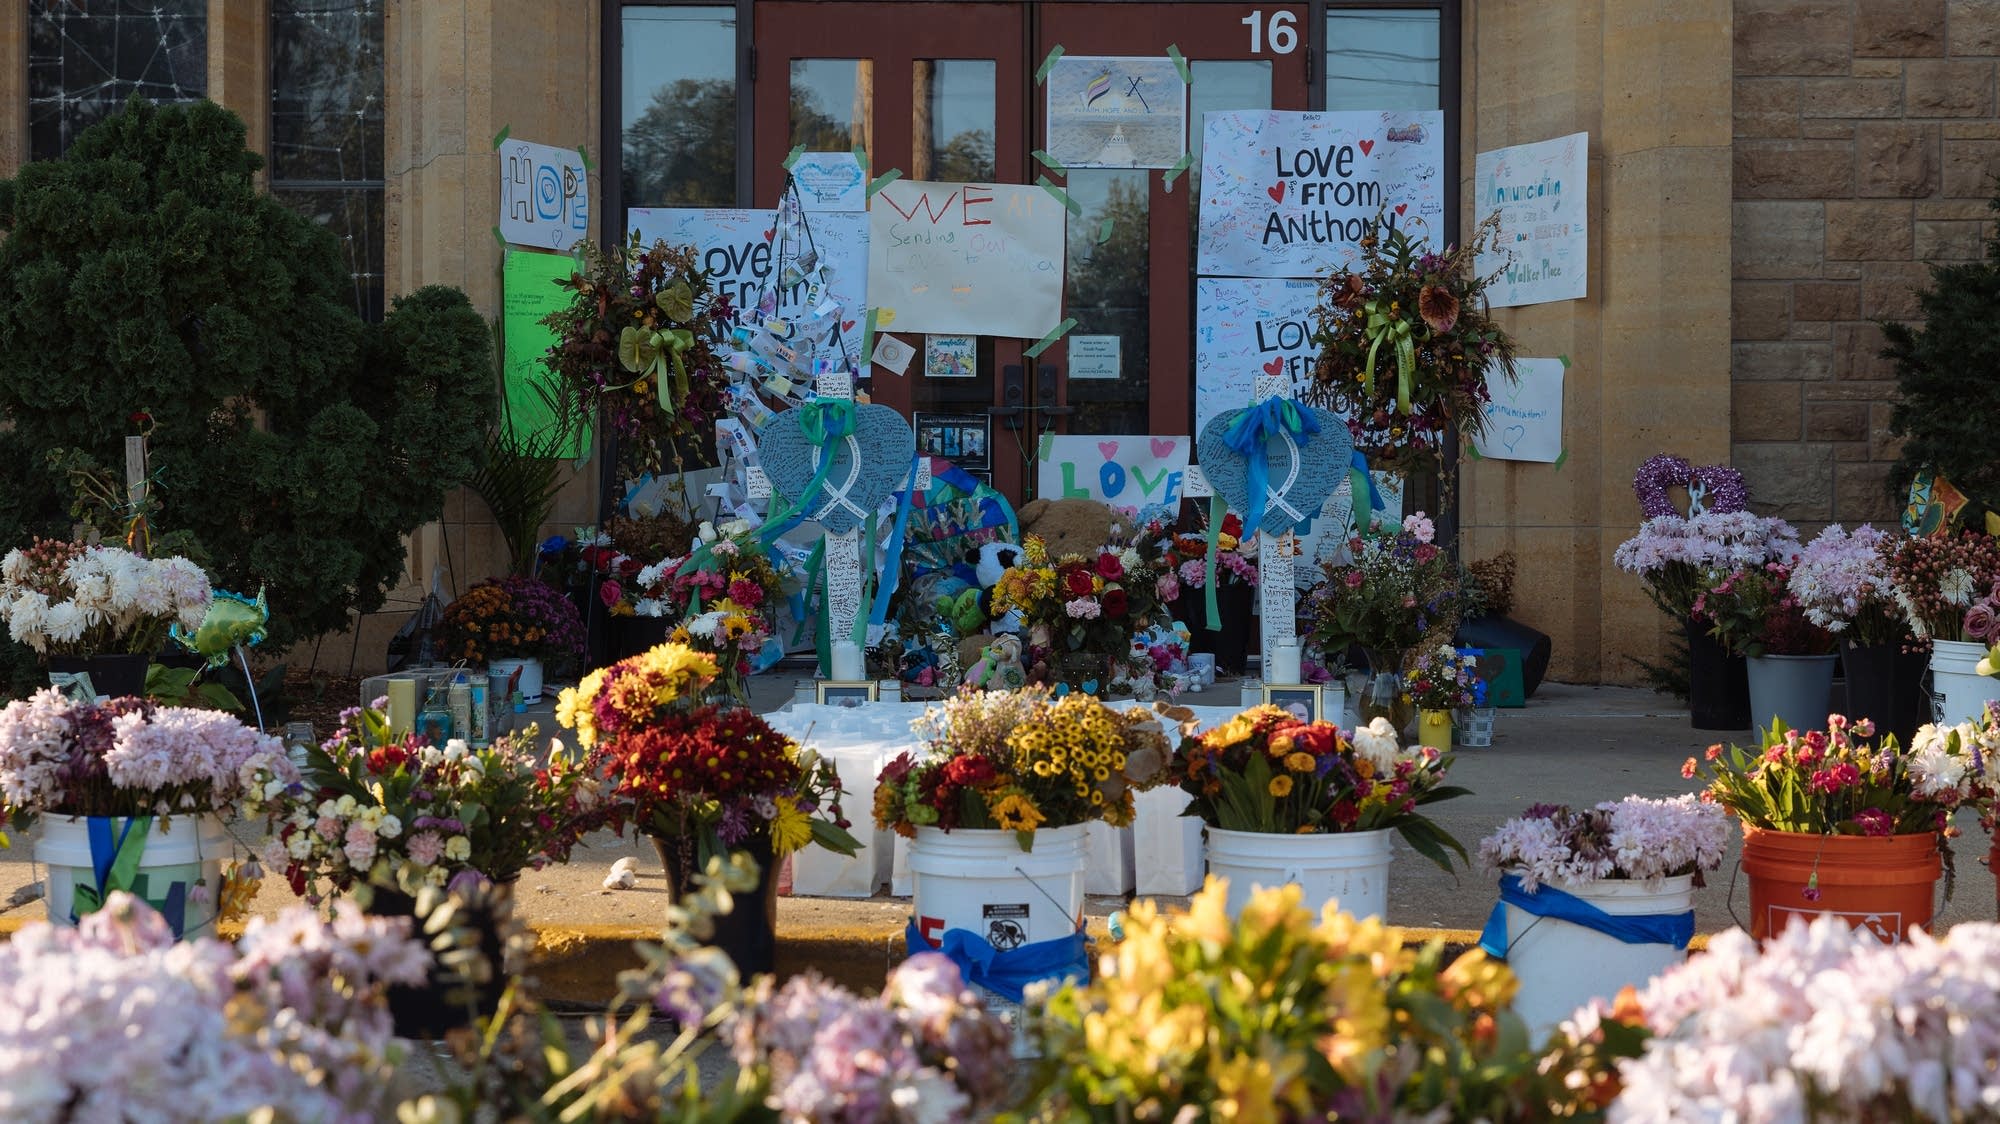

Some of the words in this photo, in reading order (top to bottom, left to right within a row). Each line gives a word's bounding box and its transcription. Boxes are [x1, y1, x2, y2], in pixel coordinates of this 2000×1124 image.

[1242, 10, 1298, 54] 16
[509, 156, 587, 229] HOPE
[880, 186, 994, 225] WE
[889, 223, 955, 247] Sending
[703, 241, 774, 278] ove
[1507, 263, 1540, 285] Walker
[1256, 320, 1331, 352] LOV
[1060, 461, 1183, 505] LOVE
